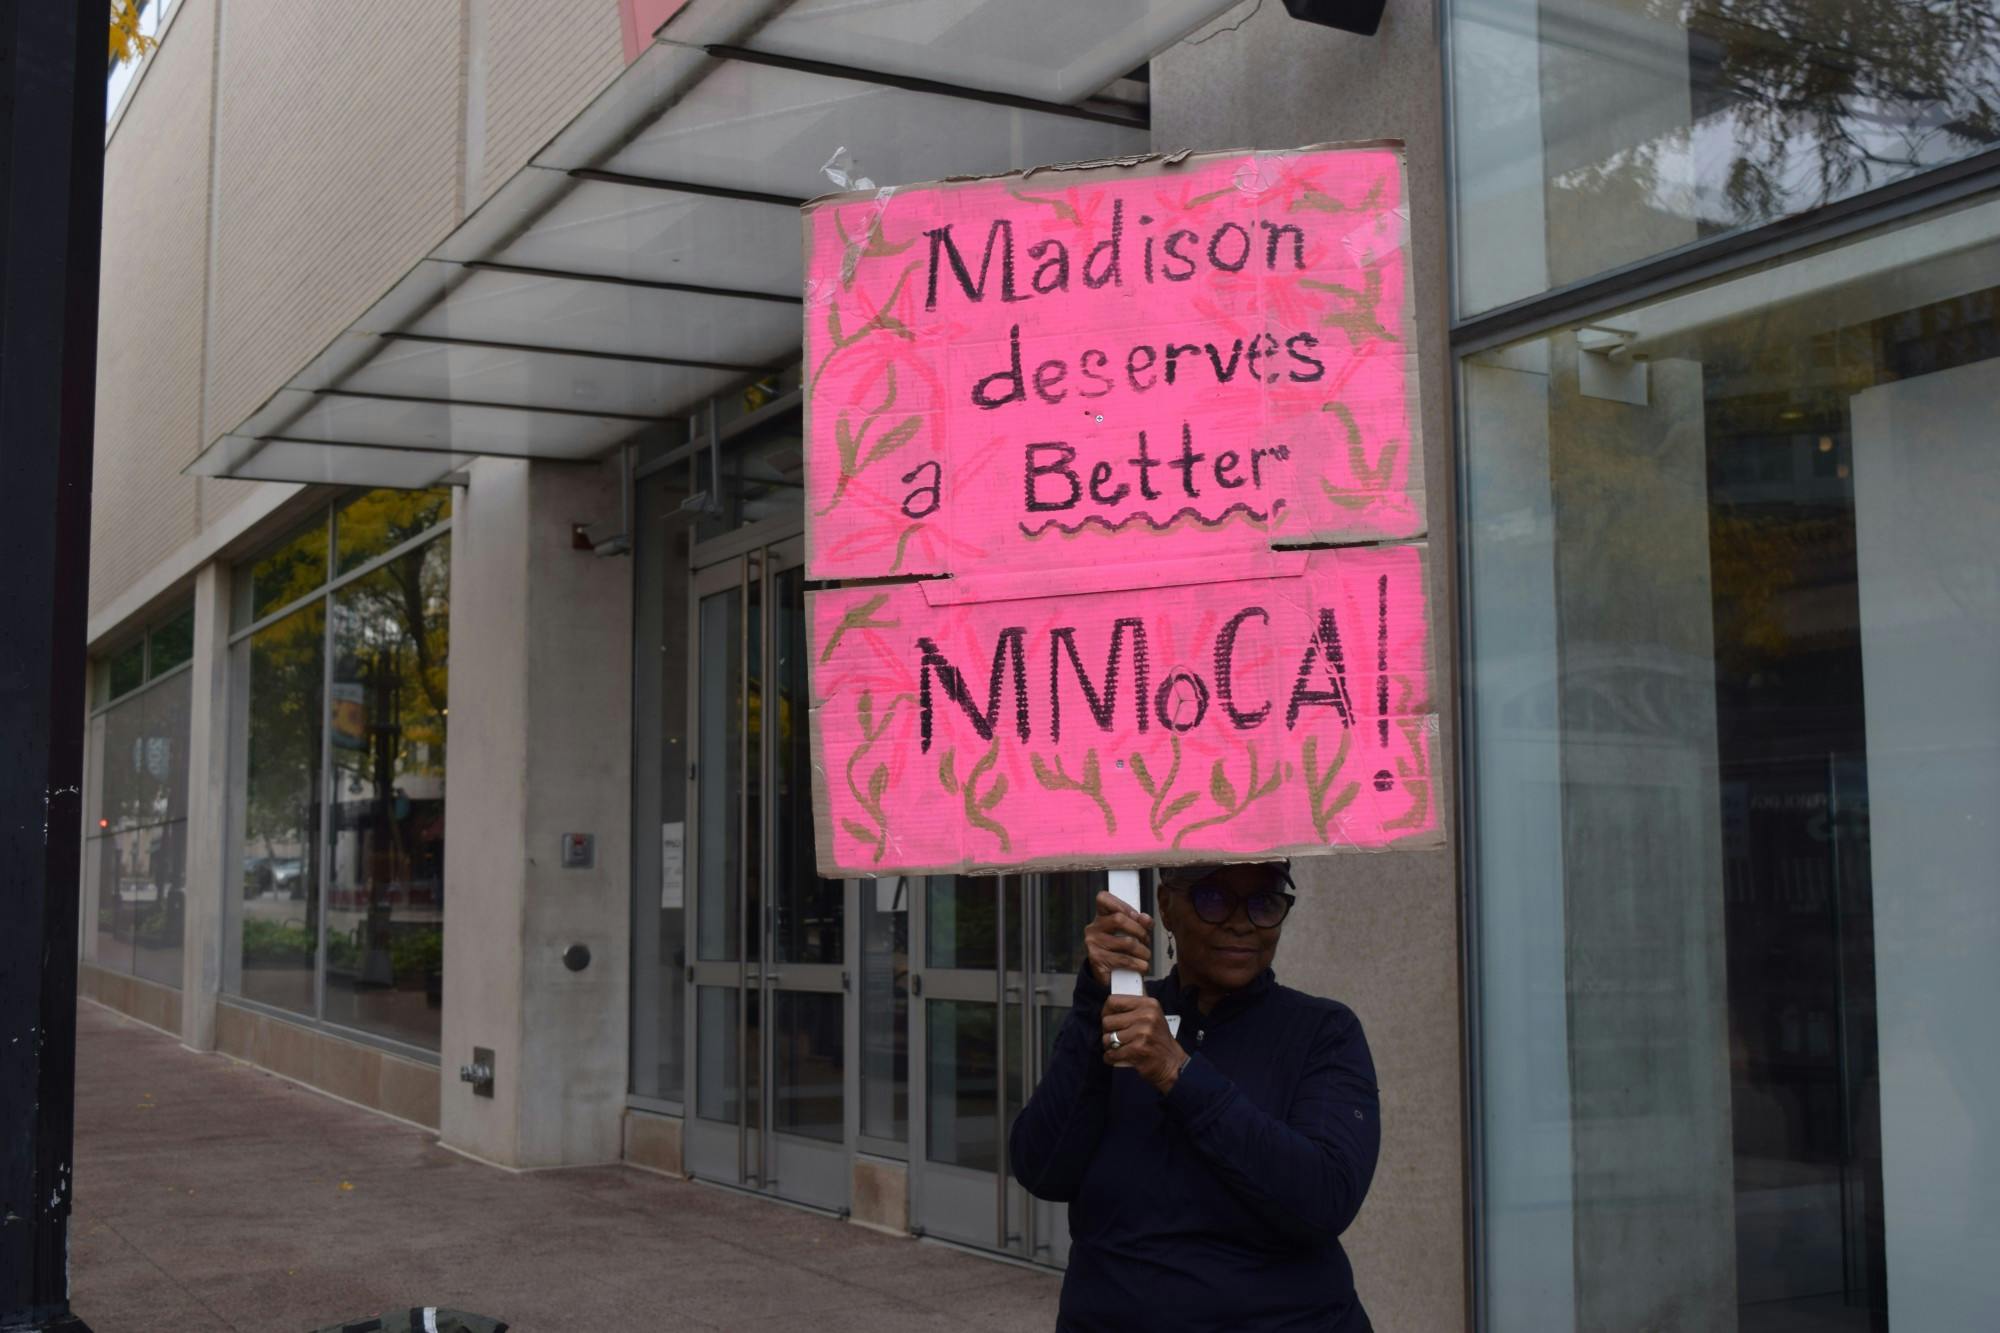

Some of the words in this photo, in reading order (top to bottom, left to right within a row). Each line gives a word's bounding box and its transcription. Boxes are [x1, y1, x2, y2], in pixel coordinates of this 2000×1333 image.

[923, 199, 1306, 312] Madison
[971, 324, 1327, 410] deserves
[902, 461, 942, 519] a
[1025, 422, 1291, 512] Better
